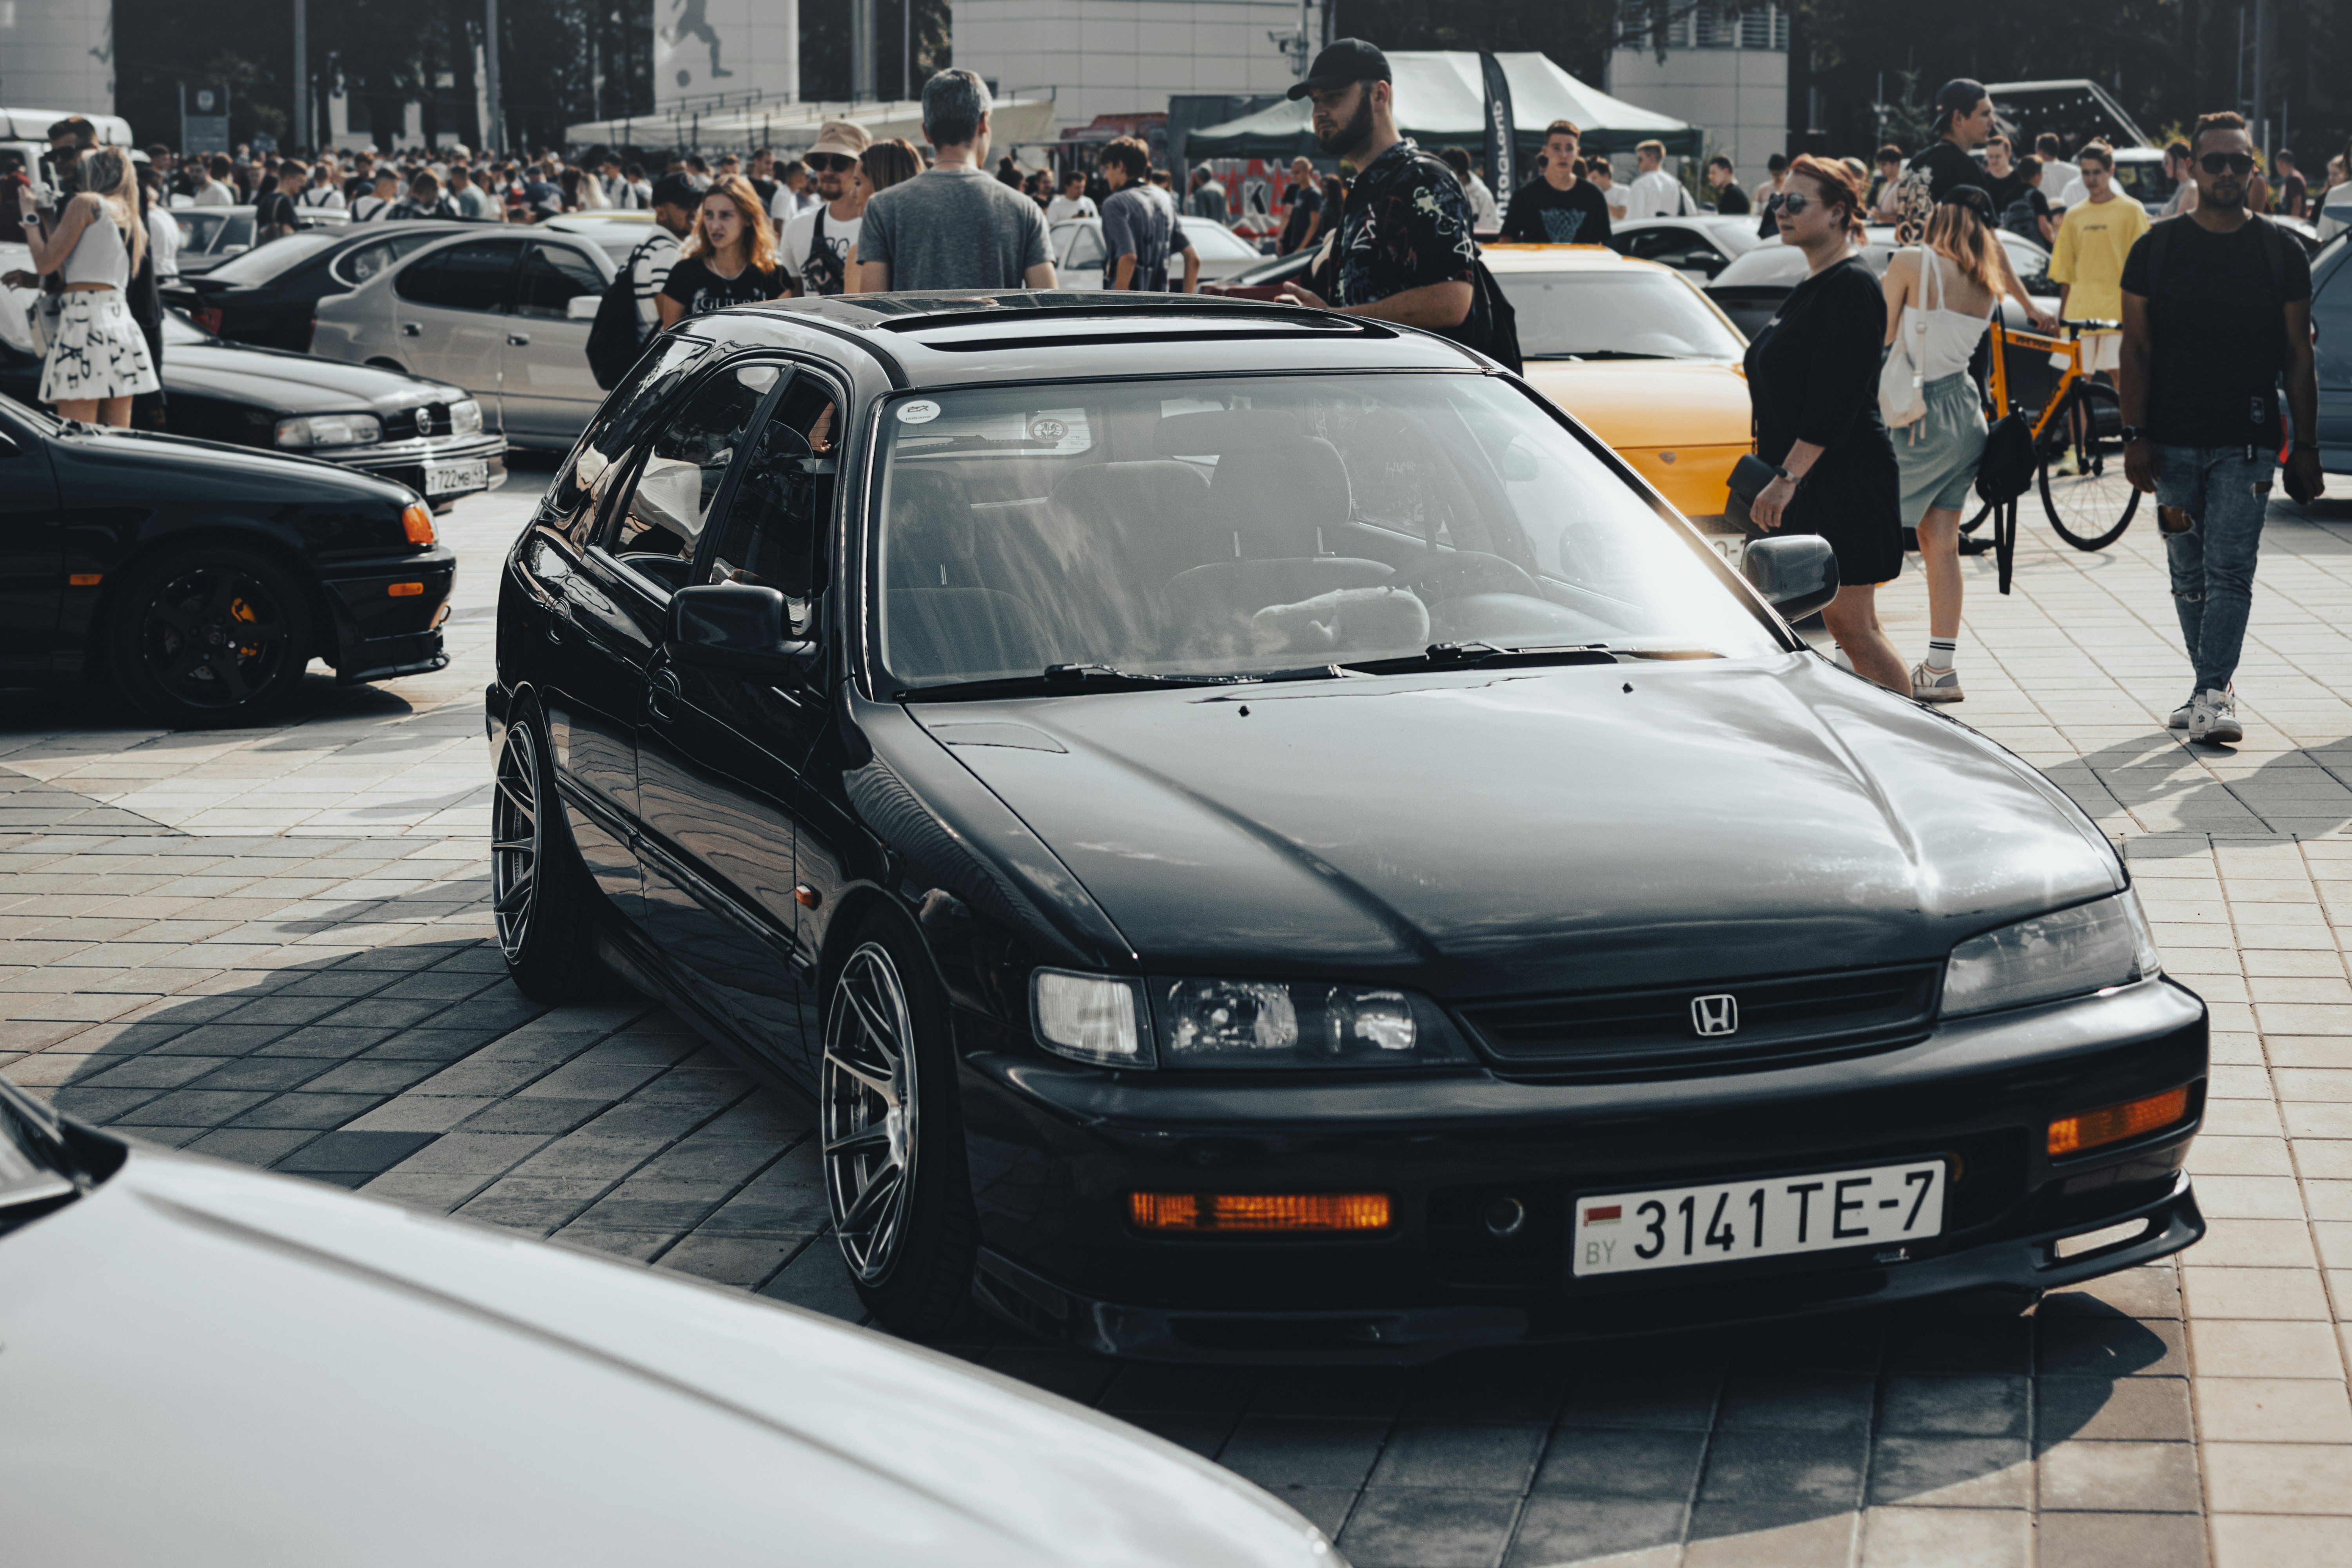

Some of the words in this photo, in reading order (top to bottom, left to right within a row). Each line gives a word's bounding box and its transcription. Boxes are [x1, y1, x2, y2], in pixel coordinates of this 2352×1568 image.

[1634, 1188, 1764, 1259] 3141
[1786, 1170, 1934, 1243] TE-7
[1585, 1239, 1617, 1265] BY
